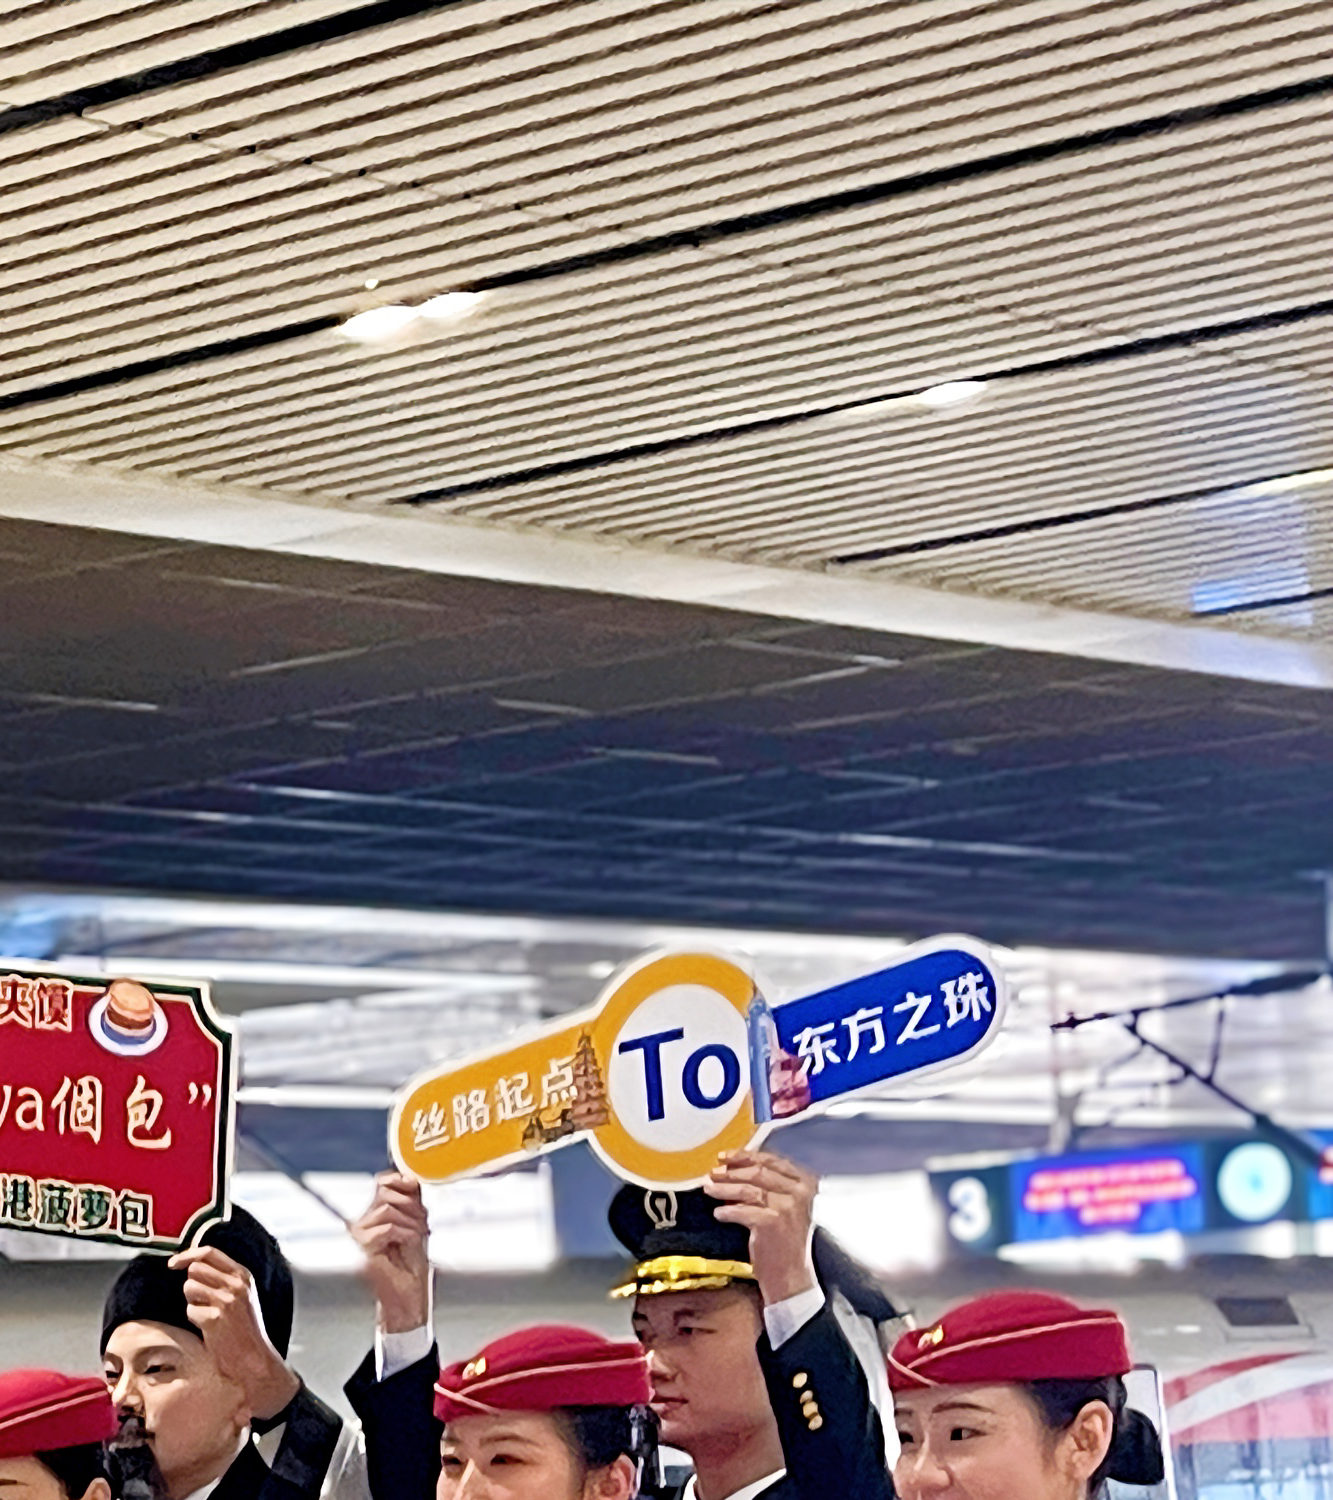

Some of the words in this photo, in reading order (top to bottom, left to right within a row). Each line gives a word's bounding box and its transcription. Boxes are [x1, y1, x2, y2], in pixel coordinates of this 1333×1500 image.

[793, 971, 992, 1076] 东方之珠
[411, 1056, 578, 1151] 丝路起点
[618, 1027, 741, 1121] To
[948, 1176, 991, 1242] 3
